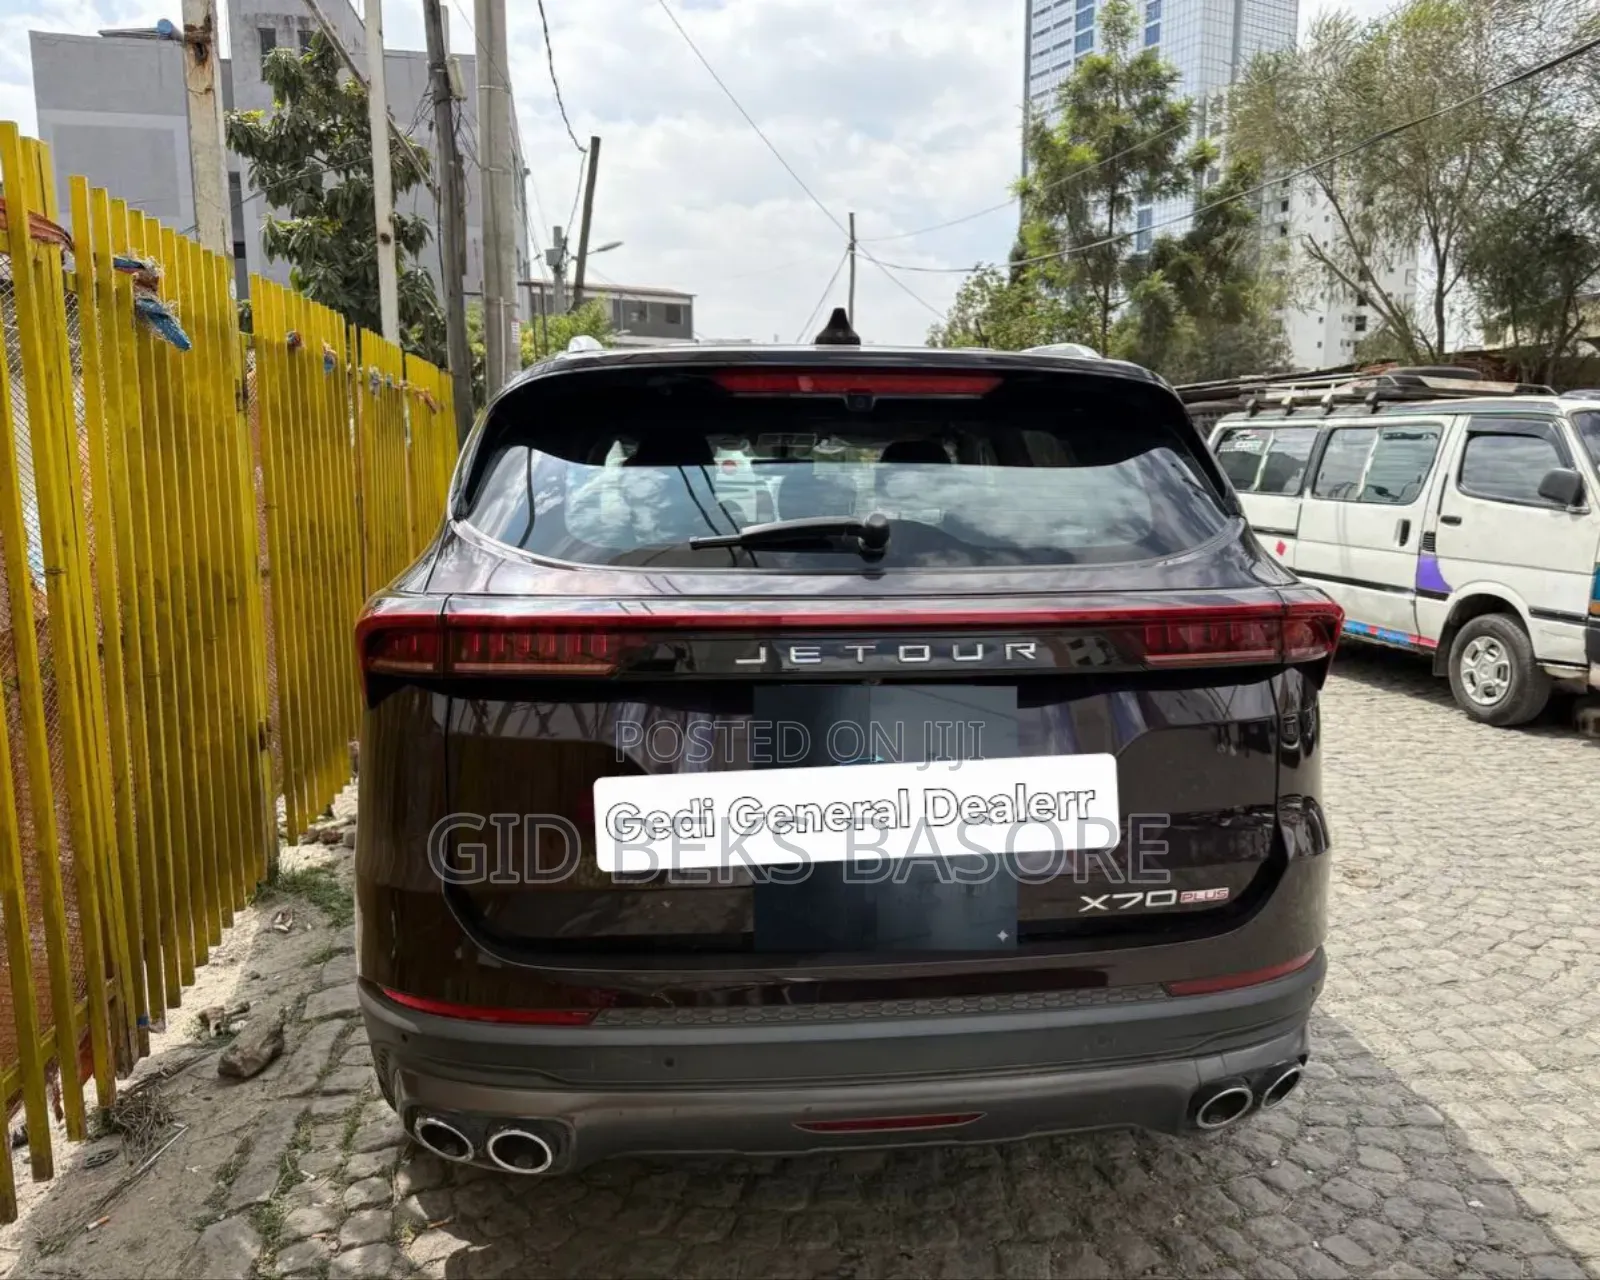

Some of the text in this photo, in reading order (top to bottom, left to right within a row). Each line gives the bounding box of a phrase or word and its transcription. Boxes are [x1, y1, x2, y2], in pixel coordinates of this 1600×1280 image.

[735, 642, 1036, 664] JETOUR
[1078, 887, 1230, 912] X70 PLUS
